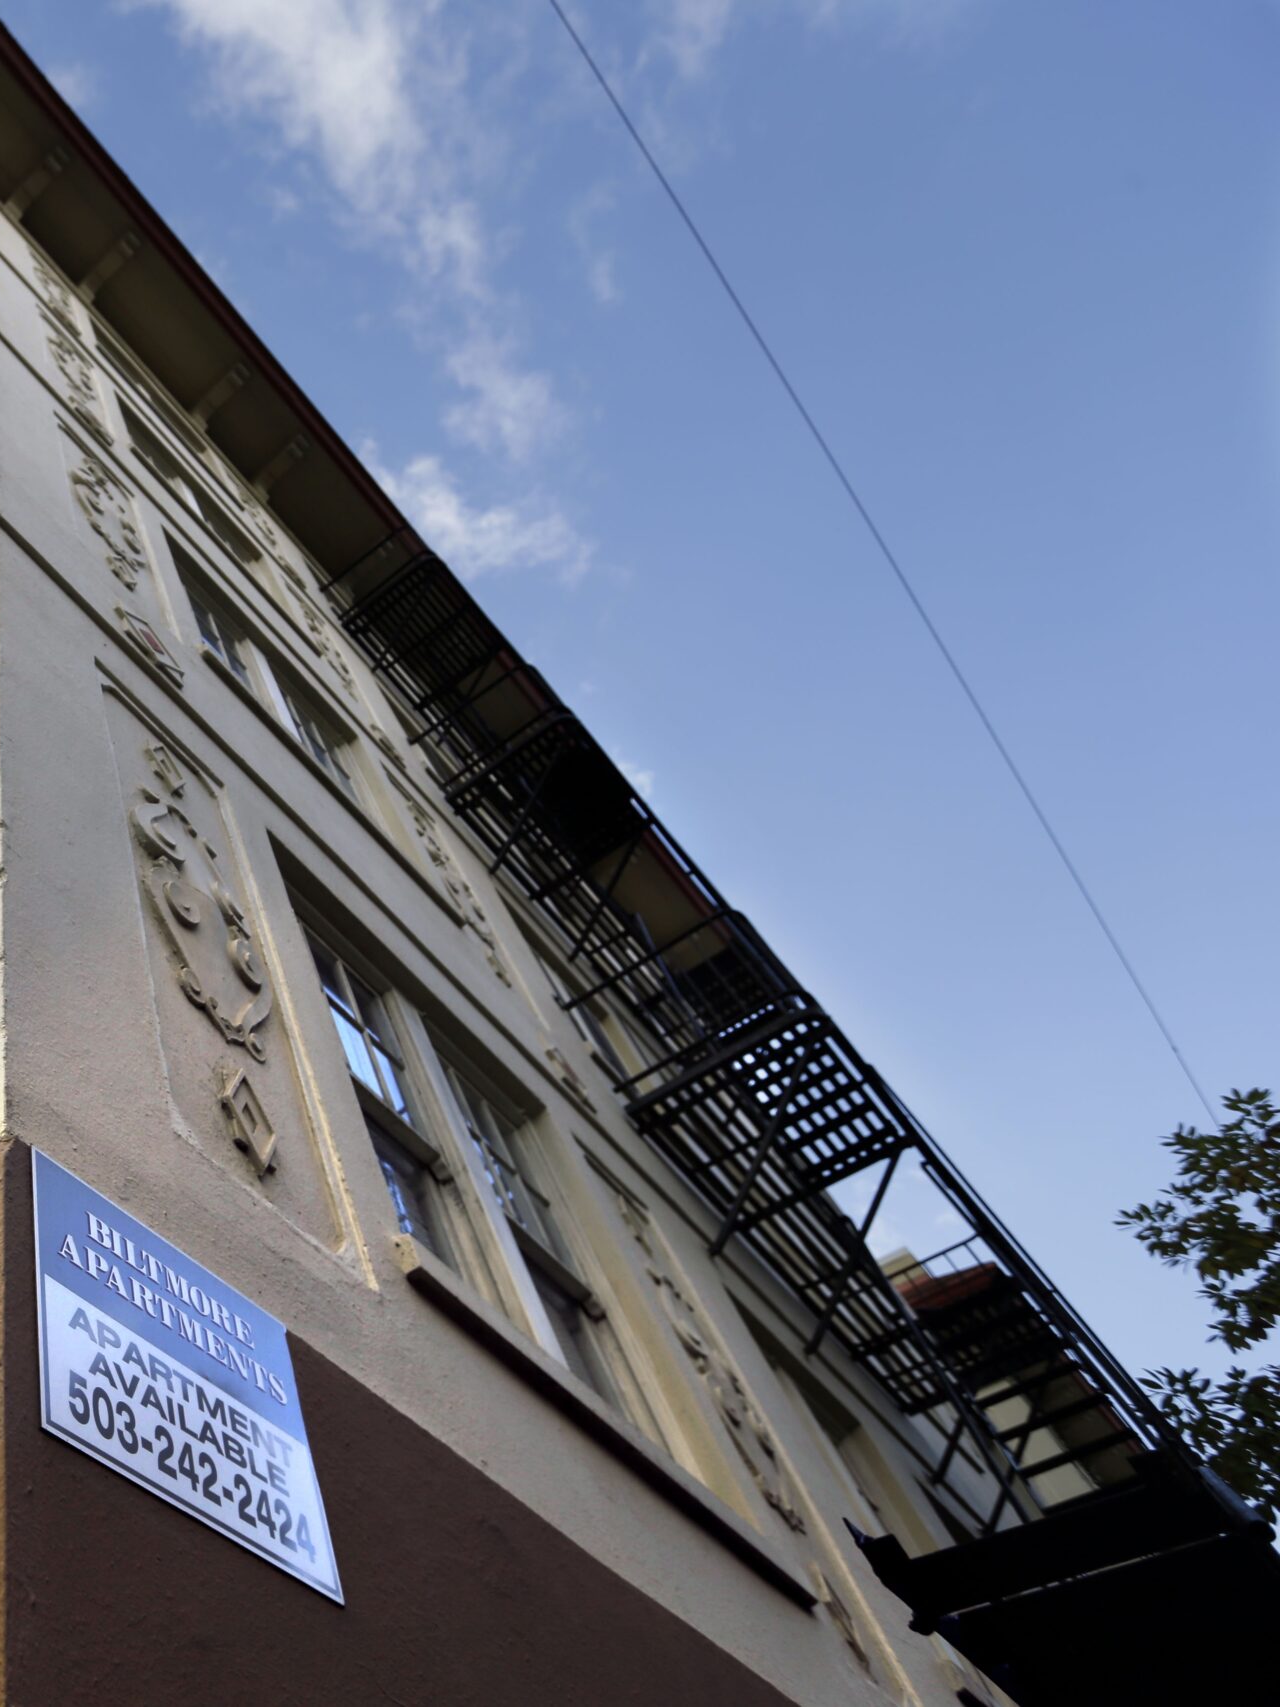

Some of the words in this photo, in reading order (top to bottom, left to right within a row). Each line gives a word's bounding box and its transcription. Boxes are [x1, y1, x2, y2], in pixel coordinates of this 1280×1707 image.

[58, 1234, 288, 1406] APARTMENTS
[85, 1211, 255, 1350] BILTMORE
[68, 1307, 293, 1468] APARTMENT
[68, 1369, 316, 1564] 503-242-2424
[89, 1353, 290, 1496] AVAILABLE
